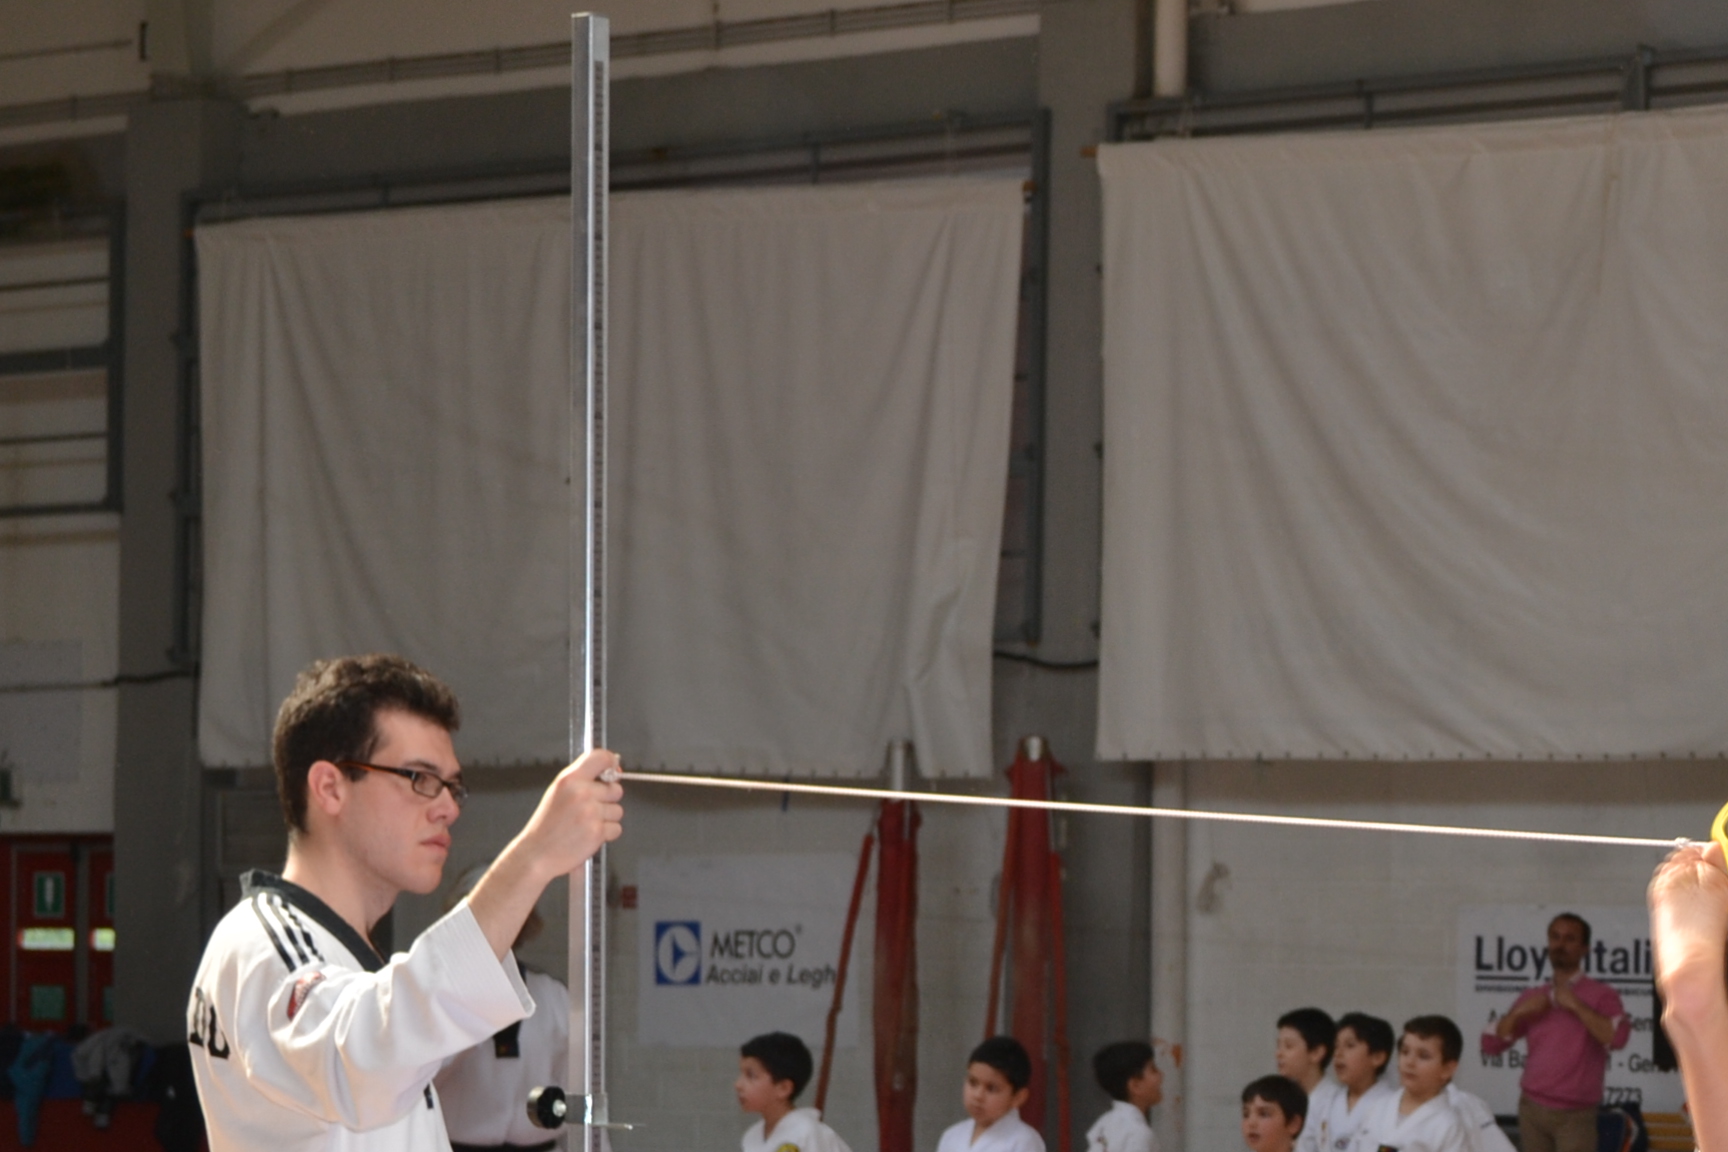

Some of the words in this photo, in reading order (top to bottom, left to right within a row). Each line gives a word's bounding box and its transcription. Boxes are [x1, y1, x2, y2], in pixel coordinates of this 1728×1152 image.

[709, 929, 796, 959] METCO
[706, 964, 764, 985] Acciai
[769, 970, 780, 984] e
